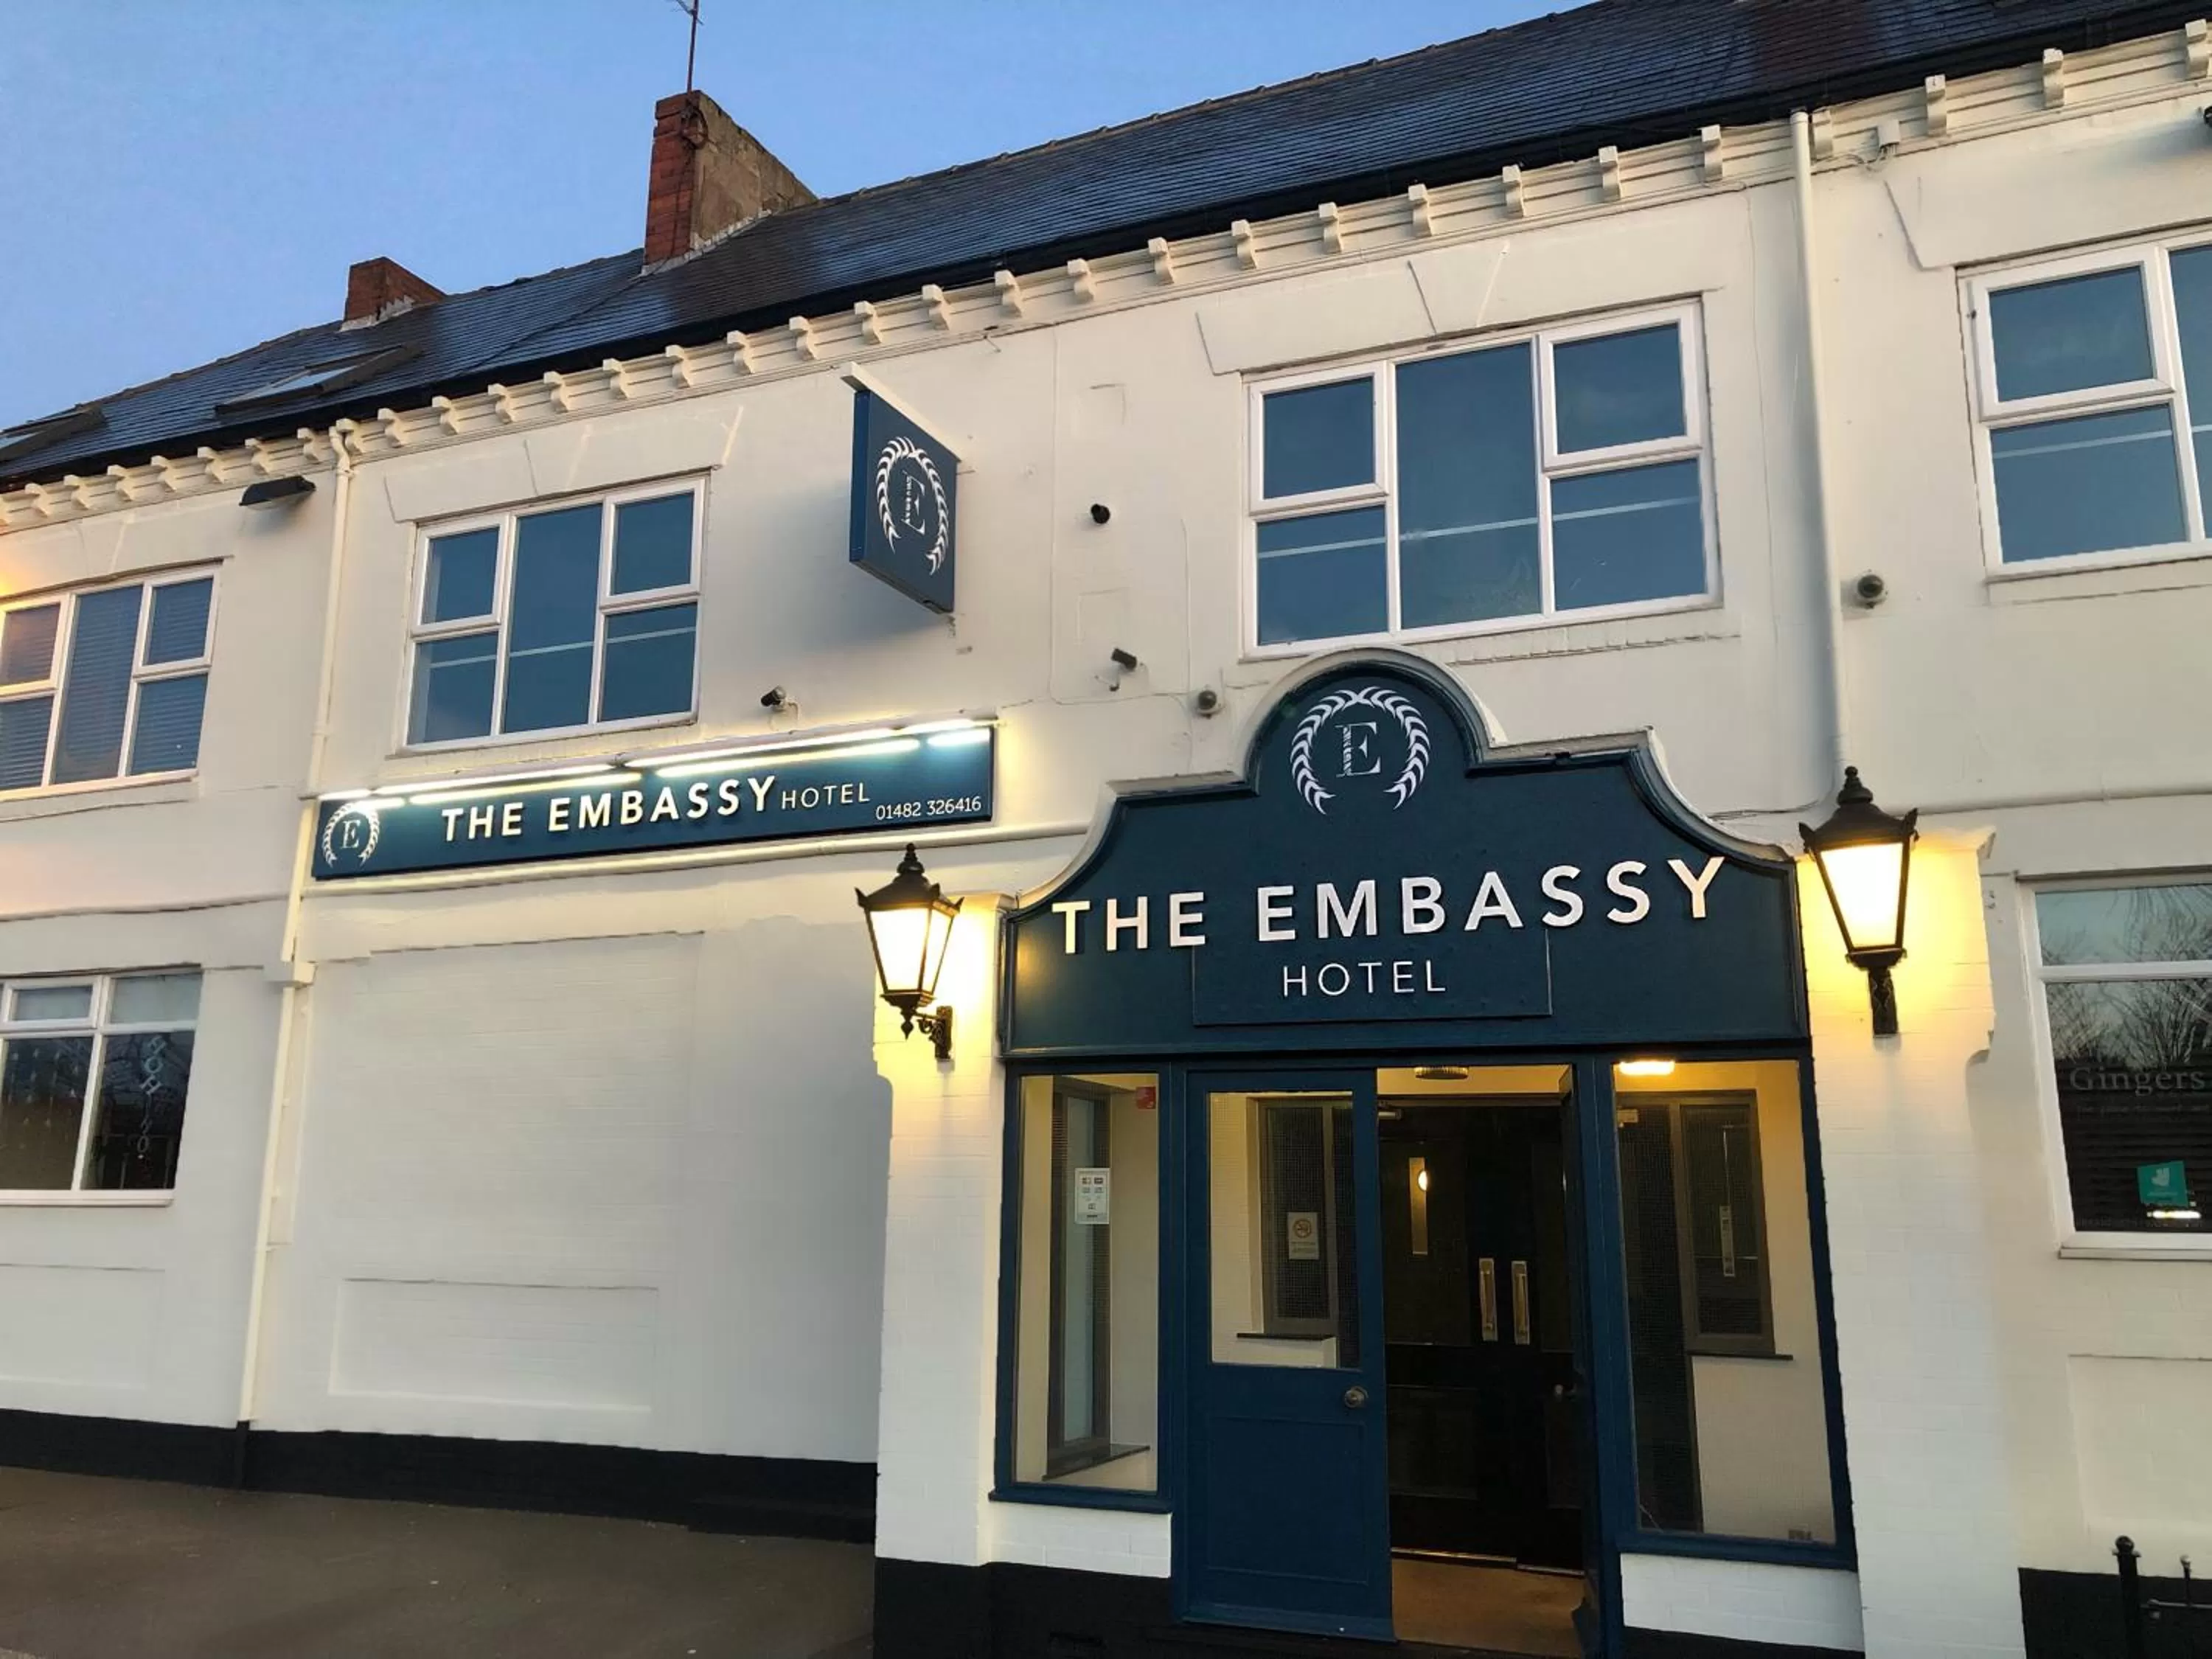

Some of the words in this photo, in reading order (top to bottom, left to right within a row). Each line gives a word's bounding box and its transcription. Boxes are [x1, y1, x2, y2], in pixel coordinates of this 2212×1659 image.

[440, 801, 524, 842] THE
[547, 775, 776, 832] EMBASSY
[781, 782, 871, 810] HOTEL
[874, 801, 922, 822] 01482
[926, 796, 982, 818] 326416
[1051, 891, 1206, 955] THE
[1257, 856, 1725, 942] EMBASSY
[1282, 960, 1447, 997] HOTEL
[2070, 1066, 2206, 1096] Gingers
